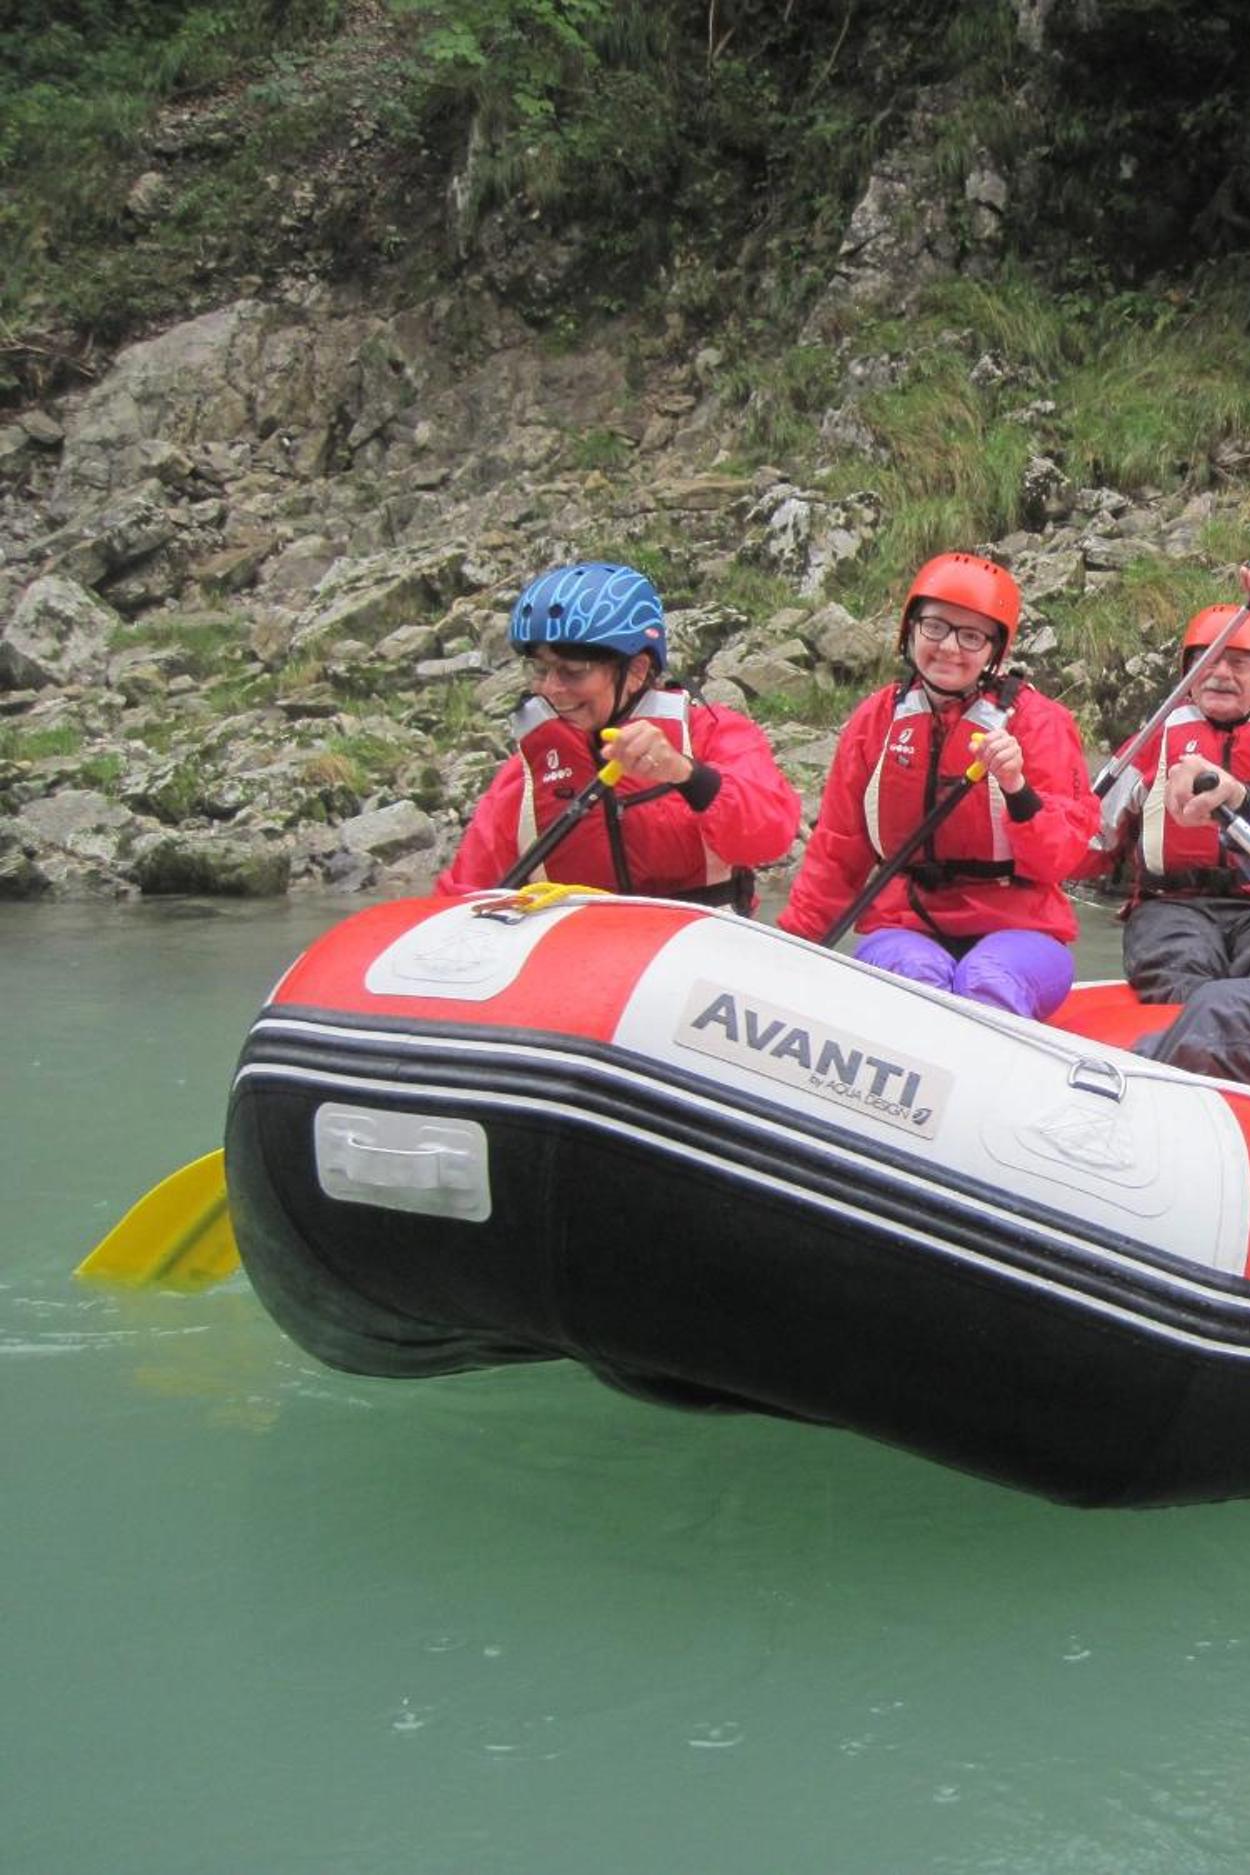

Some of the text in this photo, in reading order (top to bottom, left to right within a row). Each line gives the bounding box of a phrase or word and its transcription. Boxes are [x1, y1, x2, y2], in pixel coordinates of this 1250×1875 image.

[691, 993, 921, 1109] AVANTI
[809, 1075, 910, 1121] by AQUA DESIGN
